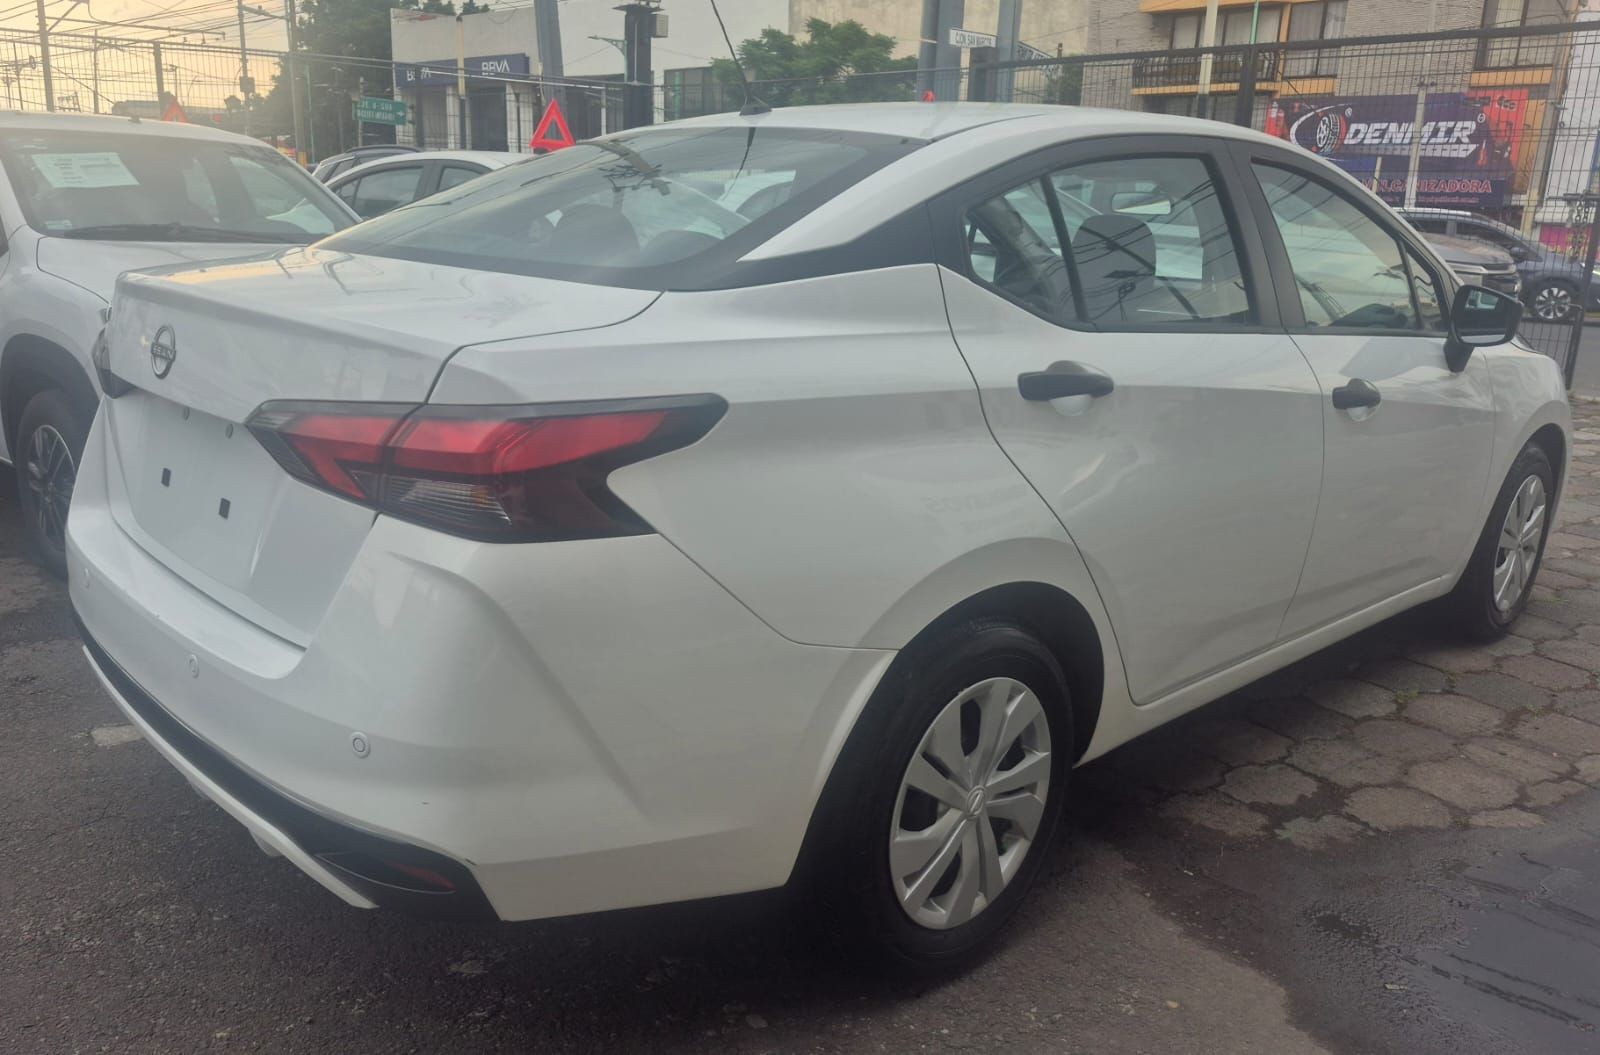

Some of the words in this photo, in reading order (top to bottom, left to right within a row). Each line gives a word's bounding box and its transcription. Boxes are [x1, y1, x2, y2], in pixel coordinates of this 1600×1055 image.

[406, 67, 431, 81] BVA
[481, 59, 510, 75] BBVA
[1344, 121, 1477, 145] DENMIR
